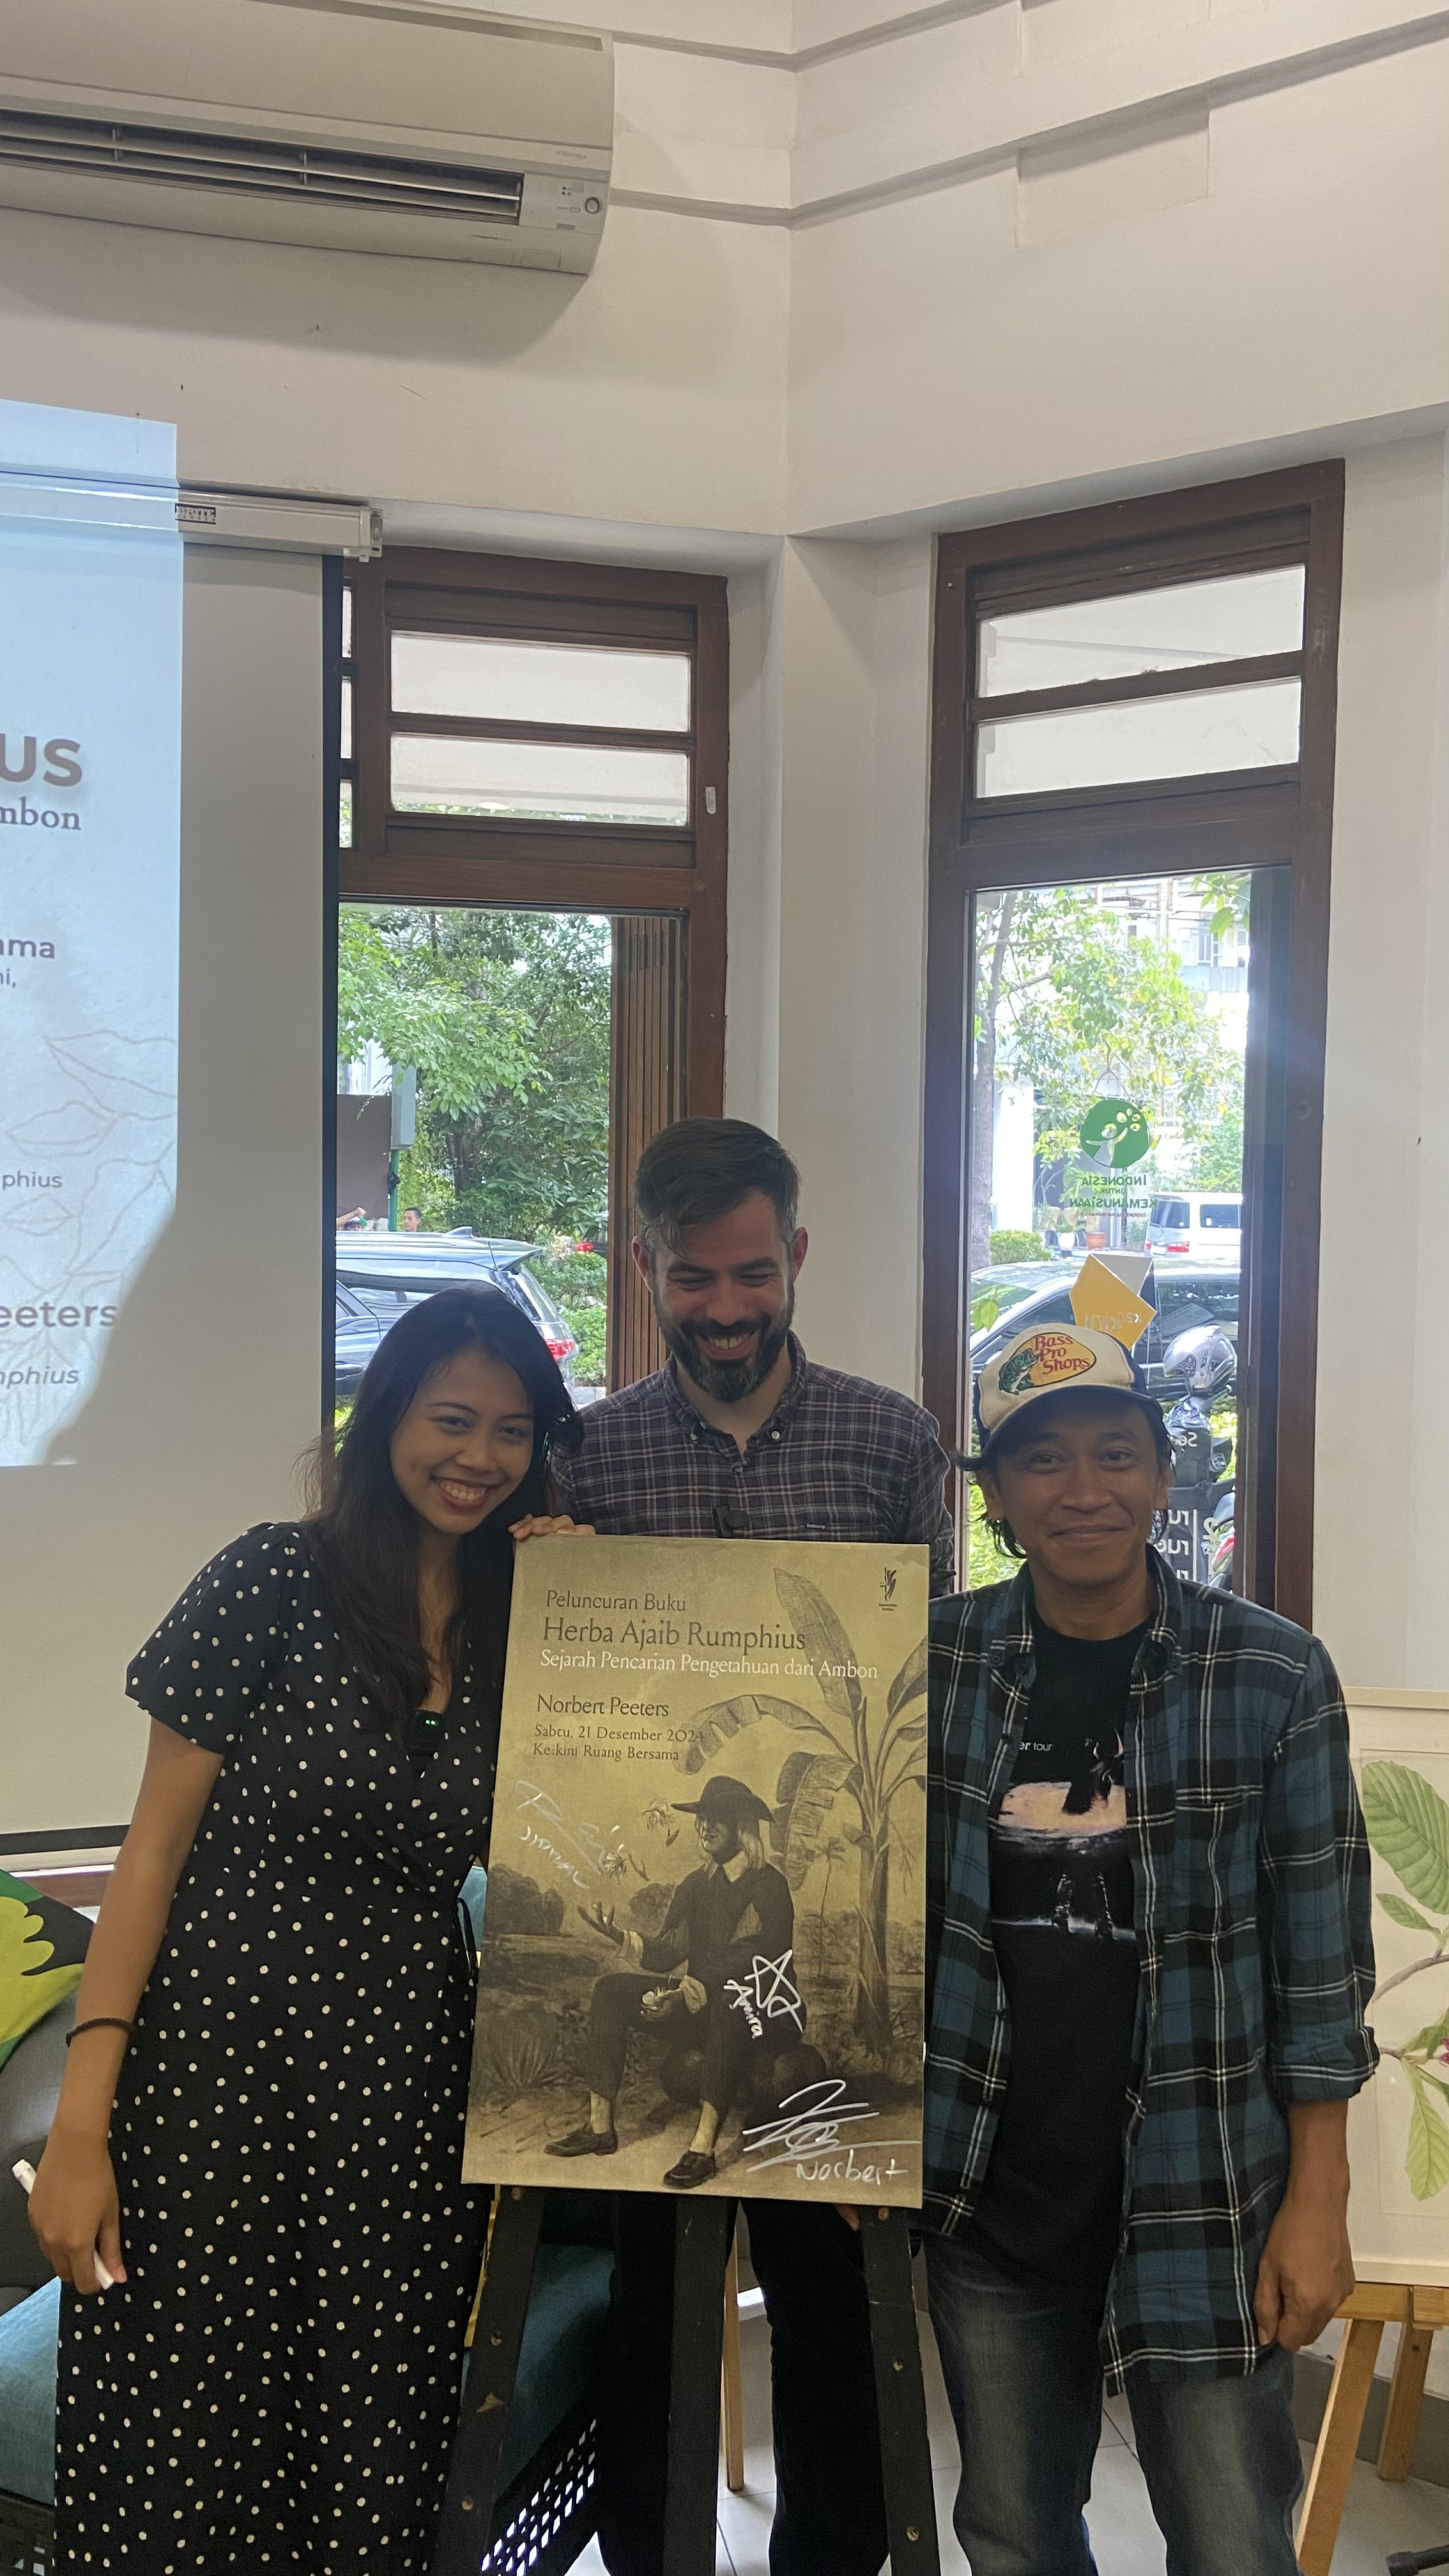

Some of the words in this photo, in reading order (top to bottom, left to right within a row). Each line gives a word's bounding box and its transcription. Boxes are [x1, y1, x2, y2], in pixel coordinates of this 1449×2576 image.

[0, 939, 55, 958] ma
[2, 1170, 63, 1190] phius
[1034, 1335, 1073, 1352] Bass
[1039, 1347, 1066, 1362] Pro
[1043, 1358, 1091, 1374] Shops
[0, 1366, 79, 1389] phius
[546, 1590, 638, 1609] Peluncuran
[644, 1593, 686, 1611] Buku
[543, 1616, 613, 1643] Herba
[620, 1618, 680, 1651] Ajaib
[687, 1621, 806, 1656] Rumphius
[540, 1648, 595, 1671] Sejarah
[601, 1651, 675, 1671] Pencarian
[680, 1653, 779, 1678] Pengetahuan
[784, 1657, 814, 1675] dari
[818, 1660, 878, 1678] Ambon
[537, 1694, 605, 1714] Norbert
[610, 1696, 670, 1717] Peeters
[534, 1724, 573, 1739] Sabtu,
[578, 1726, 591, 1738] 21
[597, 1726, 663, 1742] Desember
[667, 1729, 705, 1742] 2024
[583, 1745, 622, 1762] Ruang
[627, 1746, 679, 1760] Bersama
[1033, 1741, 1053, 1751] tour
